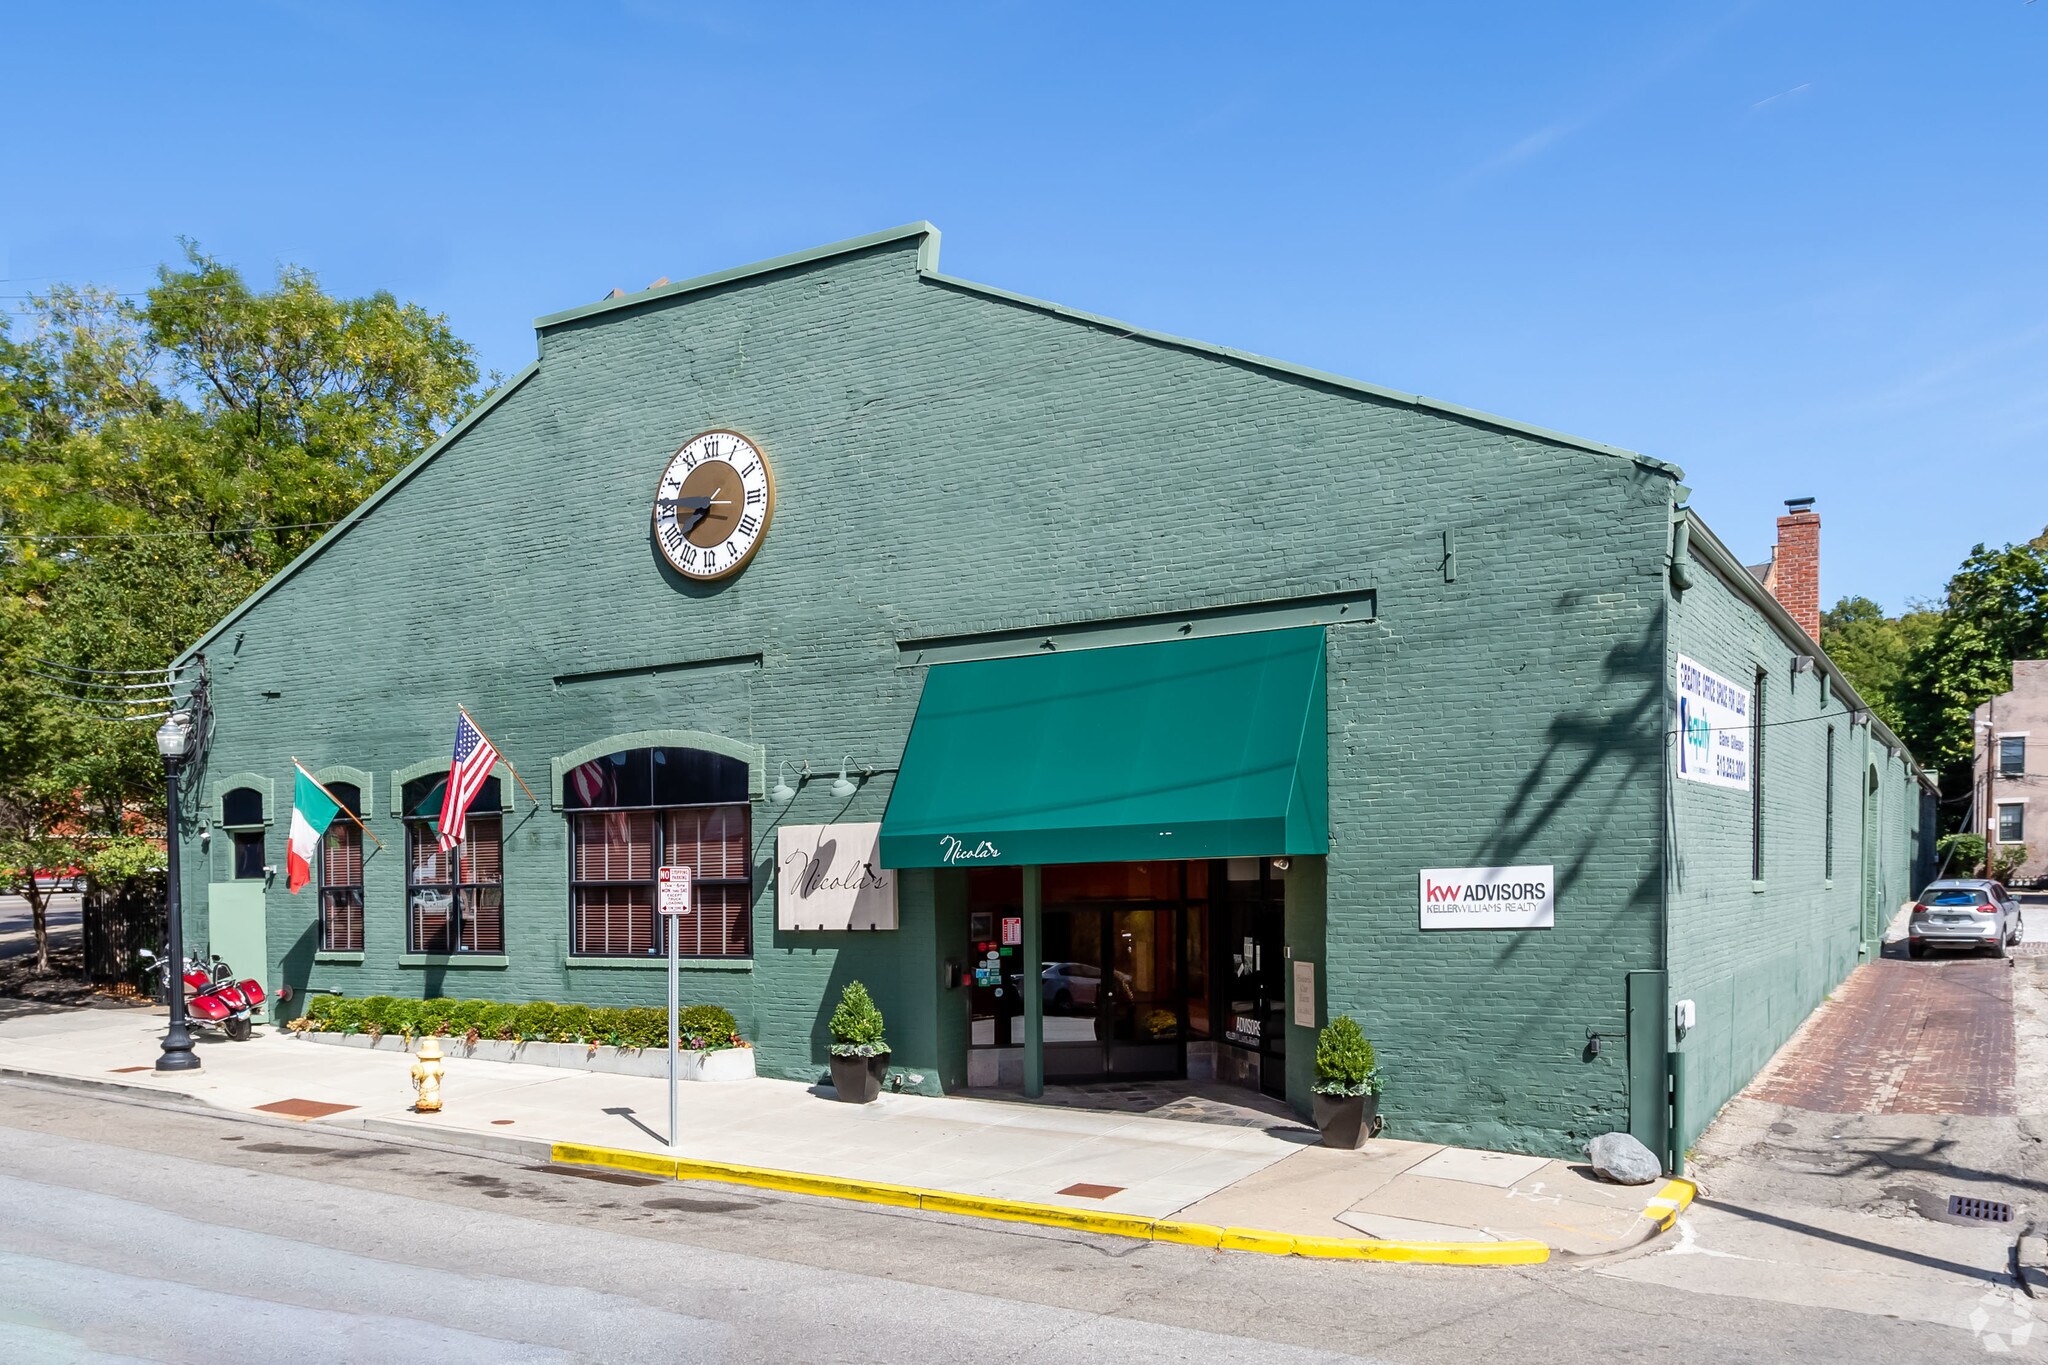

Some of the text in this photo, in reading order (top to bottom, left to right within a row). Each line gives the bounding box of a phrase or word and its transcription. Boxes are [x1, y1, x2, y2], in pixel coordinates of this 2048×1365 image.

[703, 440, 719, 459] XII
[683, 451, 697, 472] XI
[741, 461, 756, 478] II
[668, 477, 681, 490] X
[747, 488, 761, 505] III
[738, 514, 757, 537] IIII
[939, 835, 1001, 865] Nicola's
[661, 870, 669, 880] NO
[785, 848, 888, 901] Nicola's
[1463, 883, 1546, 902] ADVISORS
[1505, 902, 1539, 912] REALTY
[1236, 1016, 1261, 1037] ADVISORS
